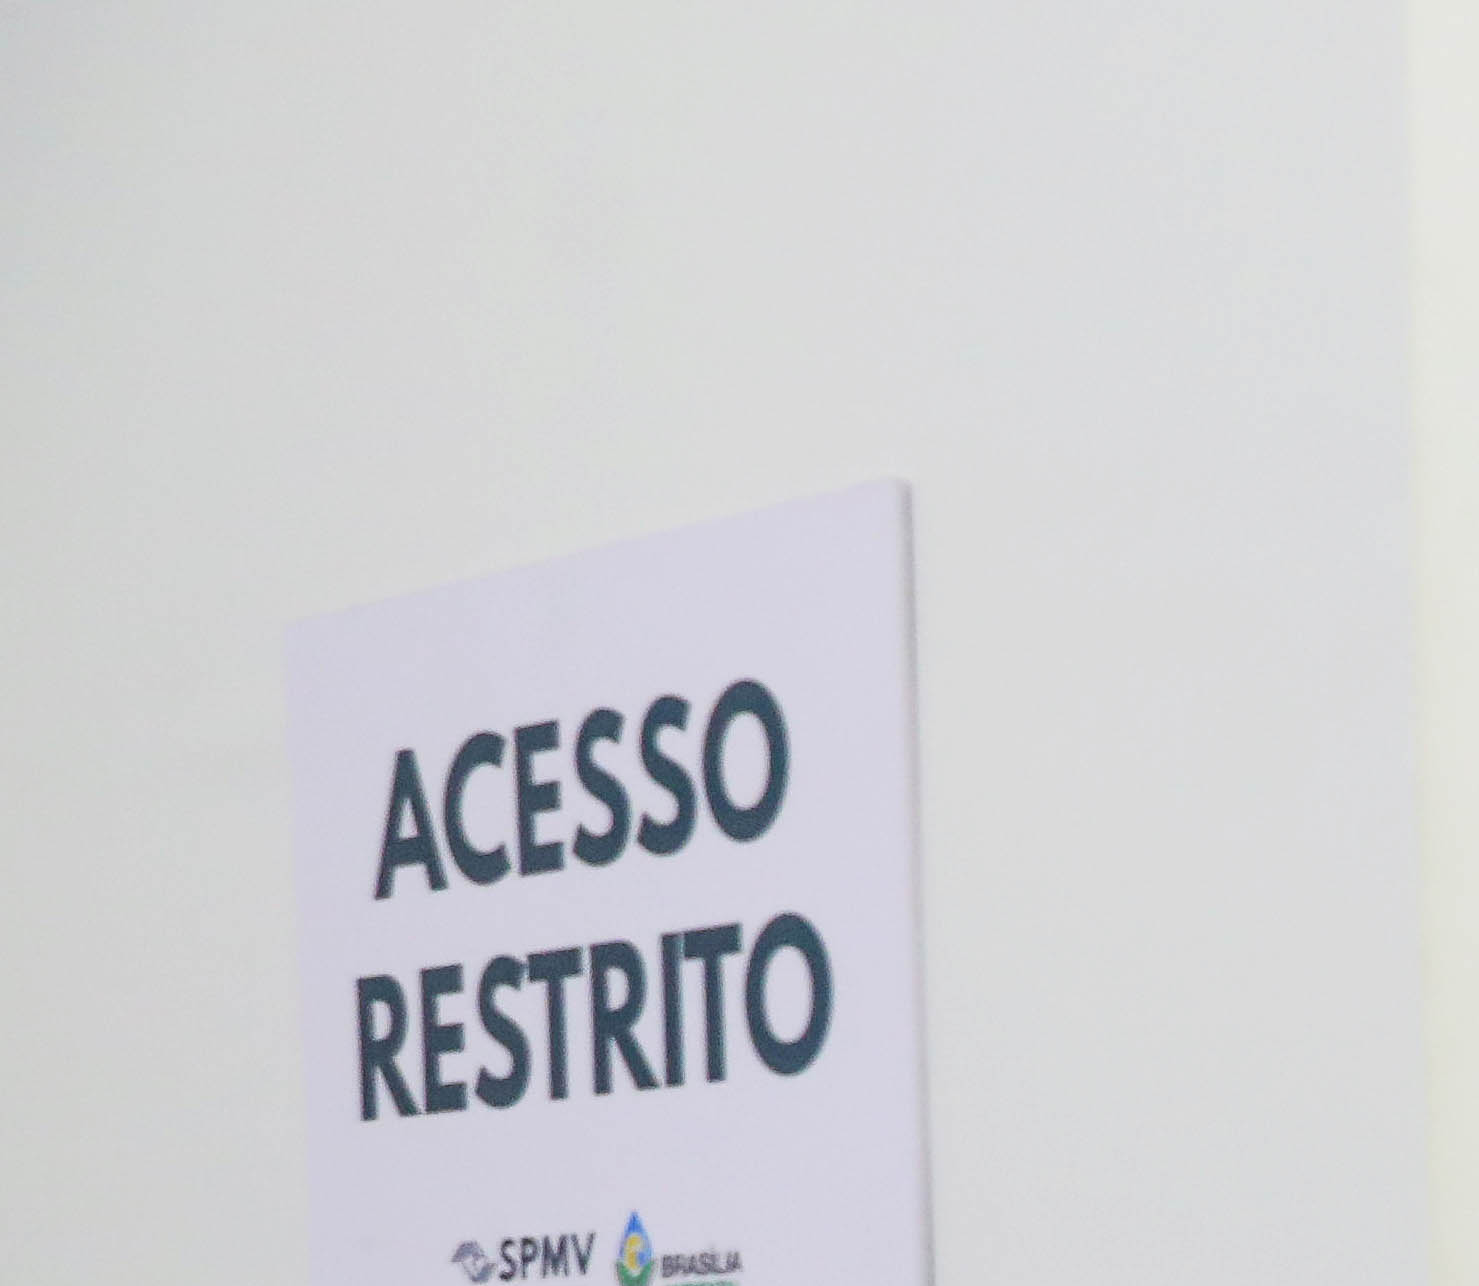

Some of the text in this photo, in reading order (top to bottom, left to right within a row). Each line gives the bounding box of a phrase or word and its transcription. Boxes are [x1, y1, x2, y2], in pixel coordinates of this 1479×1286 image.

[375, 679, 788, 900] ACESSO
[356, 912, 833, 1121] RESTRITO
[498, 1232, 595, 1281] SPMV
